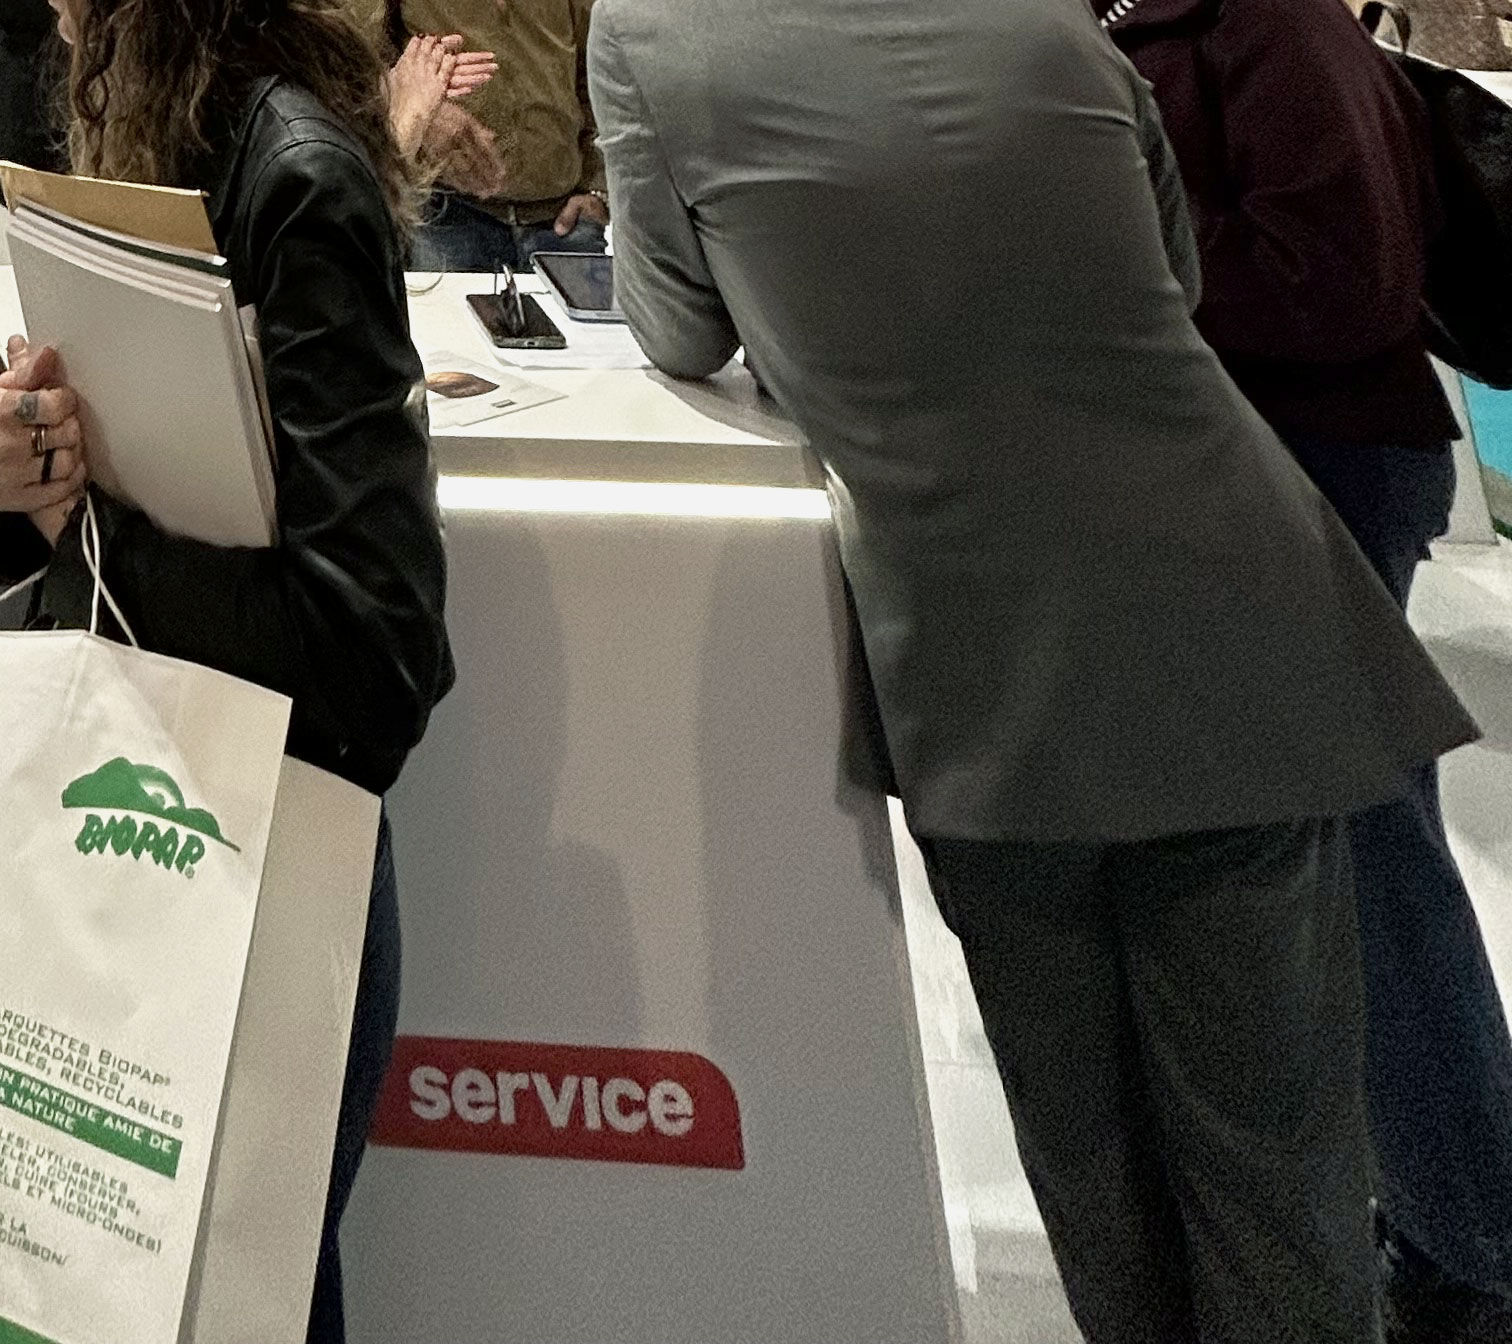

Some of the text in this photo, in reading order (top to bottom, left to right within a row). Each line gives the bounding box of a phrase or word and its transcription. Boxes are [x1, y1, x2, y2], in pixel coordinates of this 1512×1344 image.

[10, 1091, 76, 1133] NATURE
[19, 1073, 100, 1121] PRATIQUE
[102, 1111, 146, 1143] AMIE
[148, 1133, 174, 1154] DE
[60, 1066, 185, 1130] RECYCLABLES
[408, 1064, 695, 1137] service
[14, 1164, 58, 1191] CUIRE
[26, 1183, 44, 1201] ET
[34, 1143, 130, 1195] UTILISABLES
[9, 1214, 28, 1235] LA
